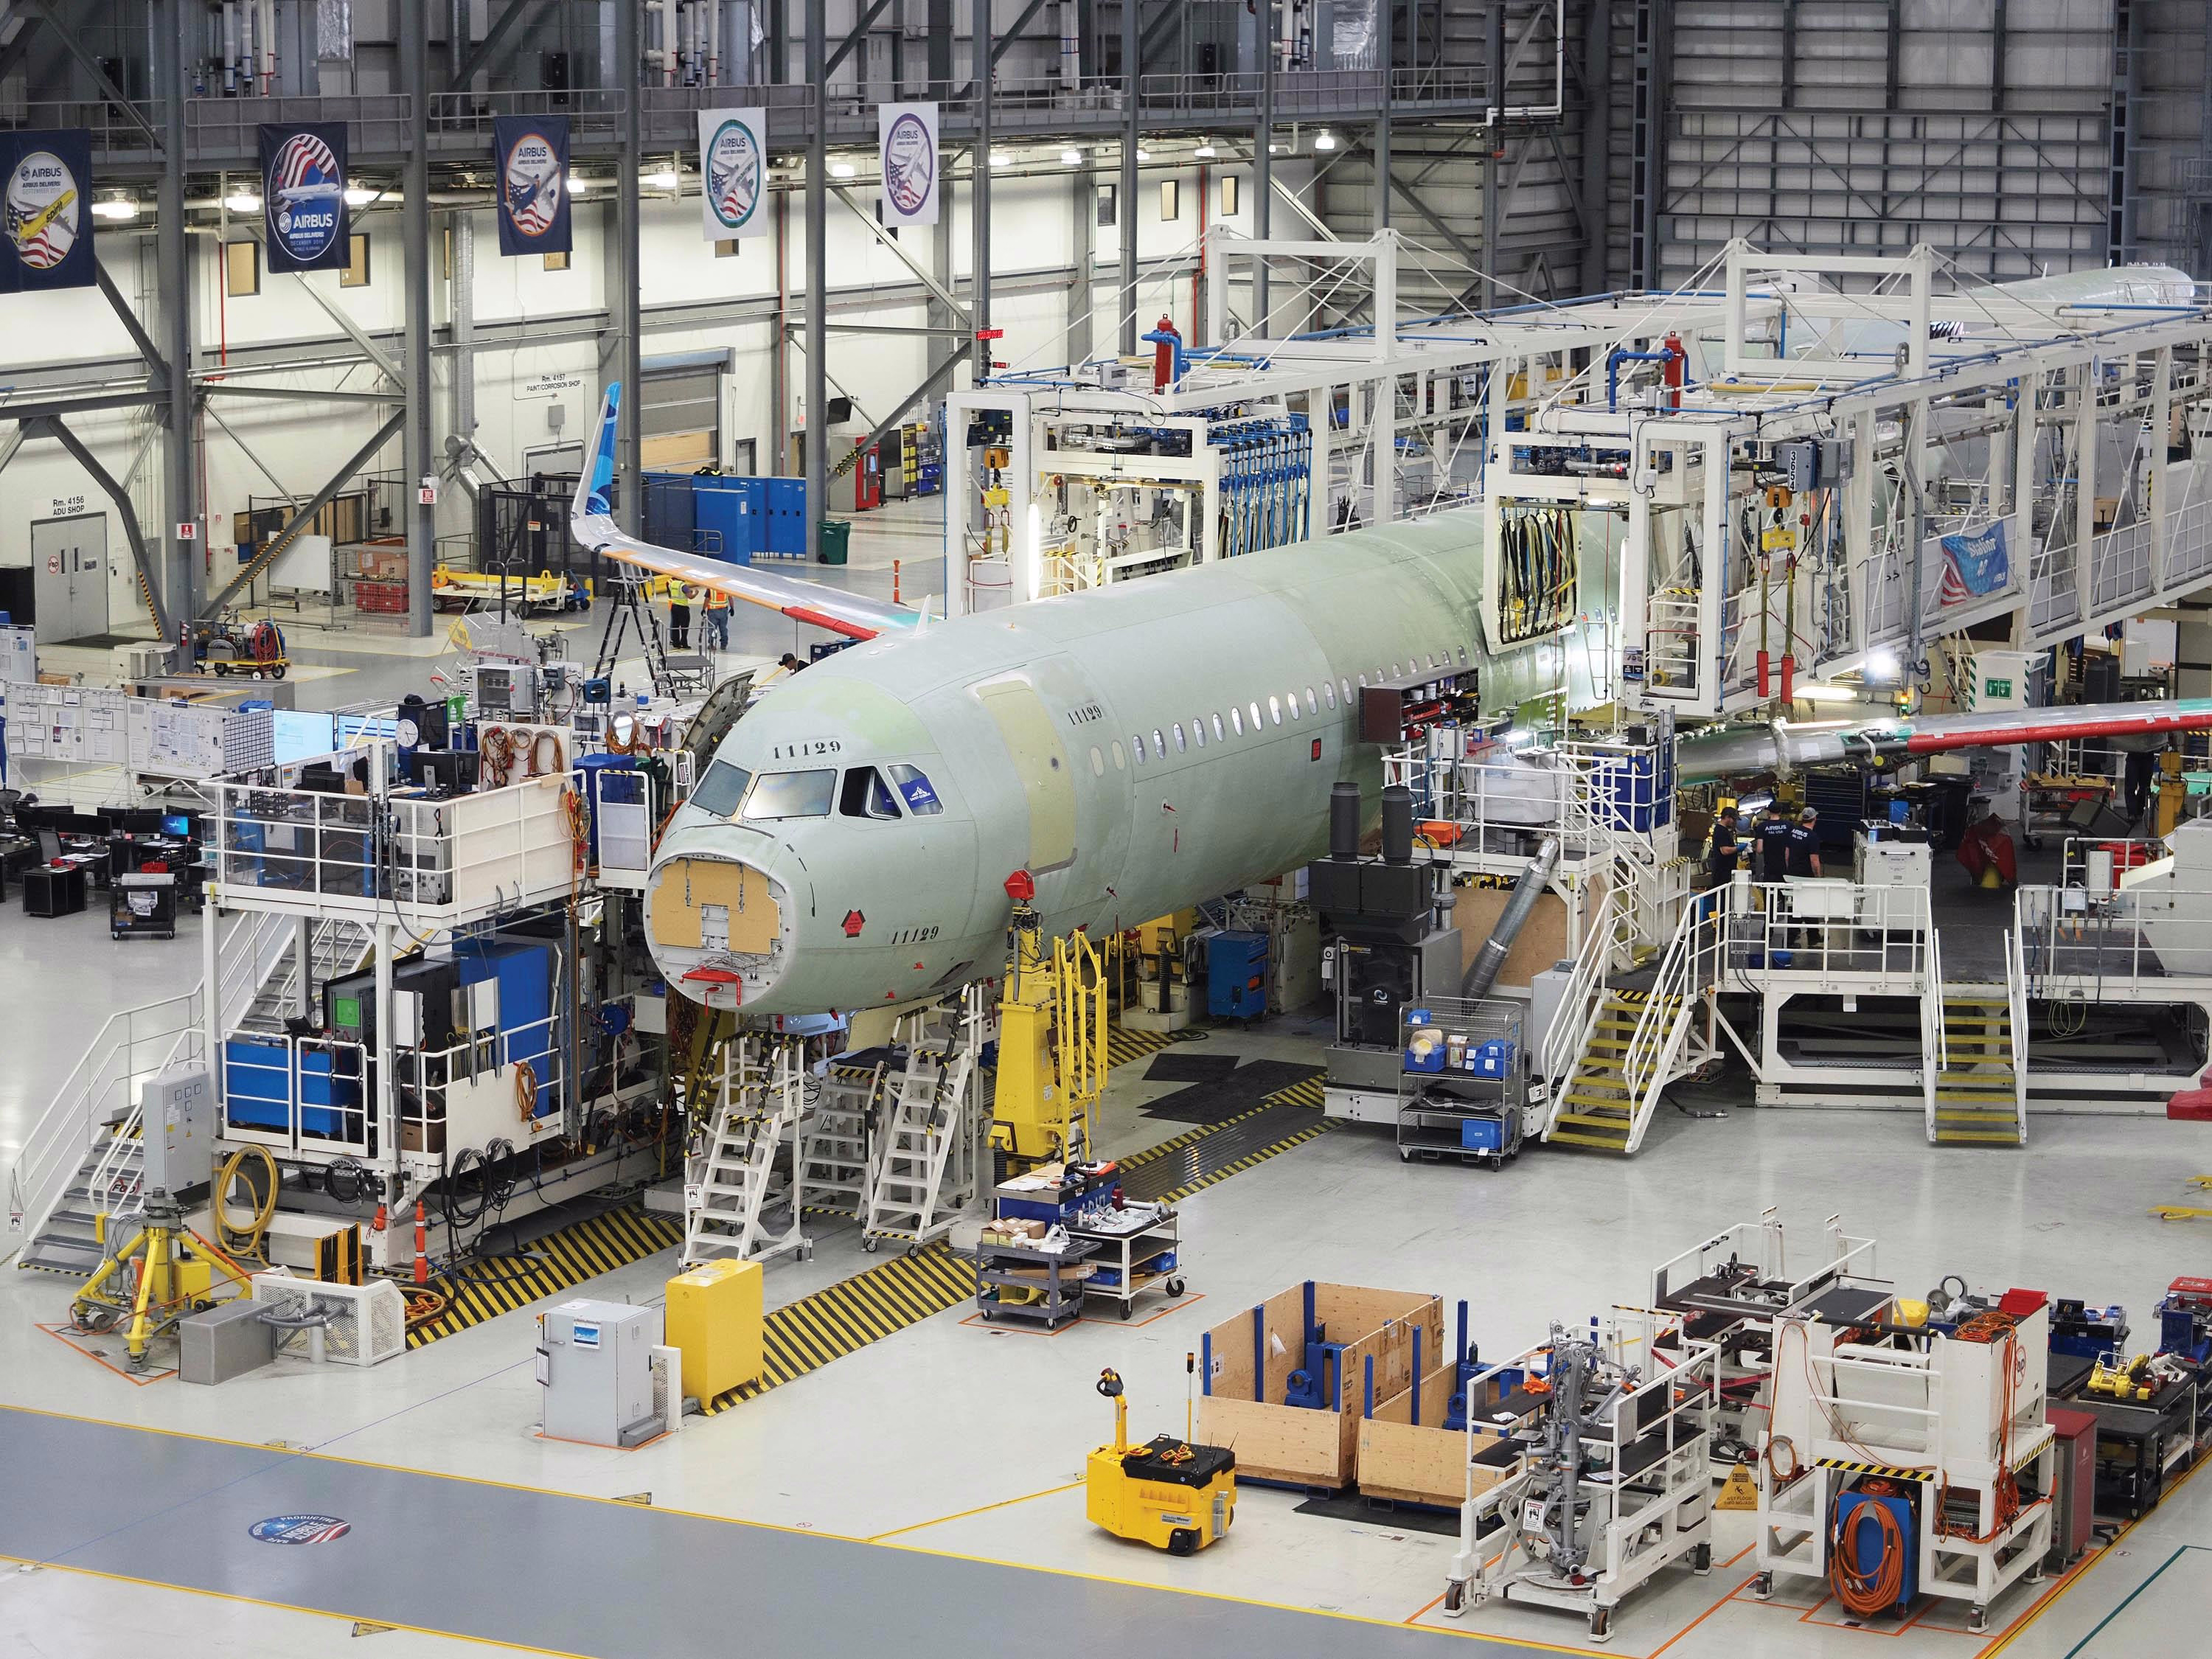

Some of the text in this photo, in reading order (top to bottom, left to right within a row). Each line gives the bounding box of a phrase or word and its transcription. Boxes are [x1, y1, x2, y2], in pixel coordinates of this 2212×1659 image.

[897, 130, 919, 139] AIRBUS
[720, 137, 746, 148] AIRBUS
[518, 147, 547, 158] AIRBUS
[32, 167, 62, 178] AIRBUS
[293, 213, 333, 229] AIRBUS
[568, 380, 581, 388] SHOP
[52, 495, 85, 507] Rm. 4156
[52, 504, 85, 516] ADU SHOP
[1068, 705, 1102, 726] 11129
[773, 740, 841, 759] 11129
[1792, 828, 1809, 838] AIRBUS
[891, 925, 939, 945] 11129
[280, 1515, 337, 1523] PRODUCTIVE
[281, 1521, 320, 1539] MOBILE
